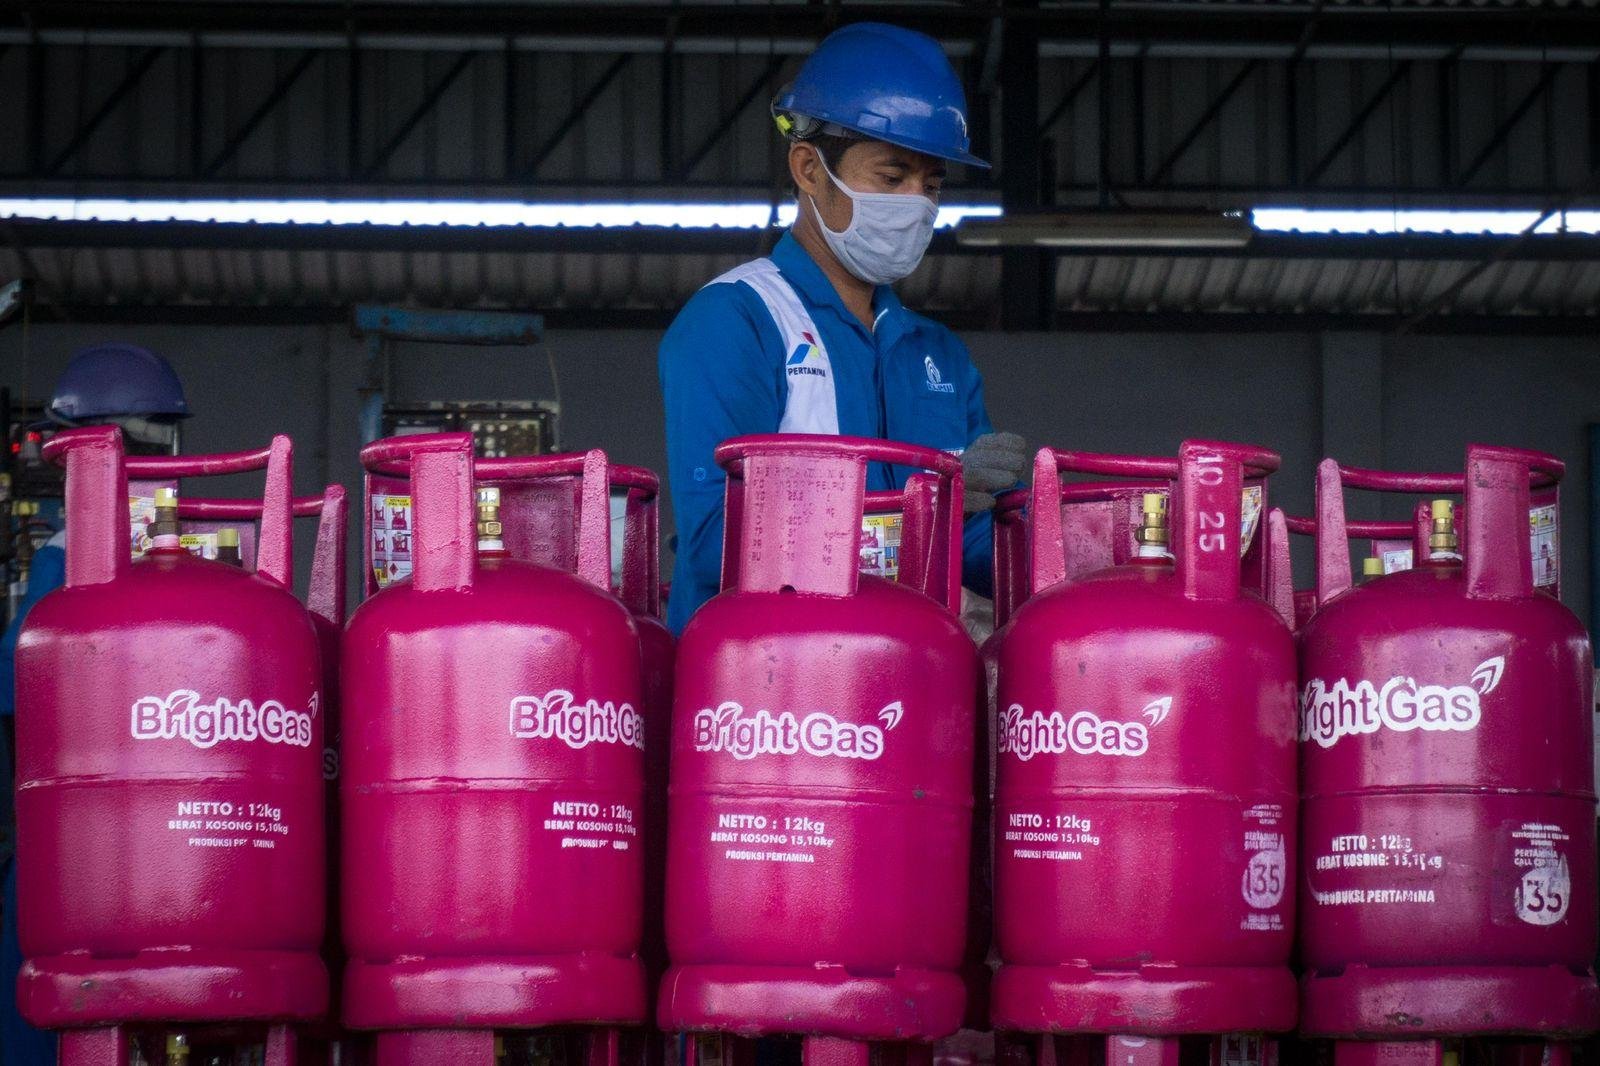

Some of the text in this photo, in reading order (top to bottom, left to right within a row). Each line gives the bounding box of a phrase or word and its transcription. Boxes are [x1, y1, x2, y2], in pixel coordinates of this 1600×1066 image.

[788, 367, 826, 377] PERTAMINA
[1200, 511, 1225, 552] 25
[1298, 677, 1381, 748] right
[1378, 676, 1481, 731] Gas
[258, 700, 311, 747] Gas
[800, 712, 884, 760] Gas
[1067, 711, 1149, 756] Gas
[178, 802, 233, 816] NETTO
[248, 803, 281, 821] 12kg
[553, 801, 599, 817] NETTO
[610, 805, 632, 822] 12kg
[168, 821, 288, 835] BERAT KOSONG 15,10kg
[544, 820, 575, 830] BERAT
[577, 821, 613, 832] KOSONG
[719, 814, 767, 830] NETTO
[784, 817, 825, 835] 12kg
[1009, 814, 1042, 828] NETTO
[1055, 814, 1091, 832] 12kg
[188, 838, 232, 847] PRODUKSI
[711, 832, 834, 847] BERAT KOSONG 15,10kg
[1005, 832, 1100, 845] BERAT KOSONG 15,10kg
[1332, 835, 1367, 852] NETTO
[725, 850, 814, 863] PRODUKSI PERTAMINA
[1014, 849, 1082, 860] PRODUKSI PERTAMINA
[1514, 858, 1532, 867] CALL
[1367, 890, 1435, 903] PERTAMINA
